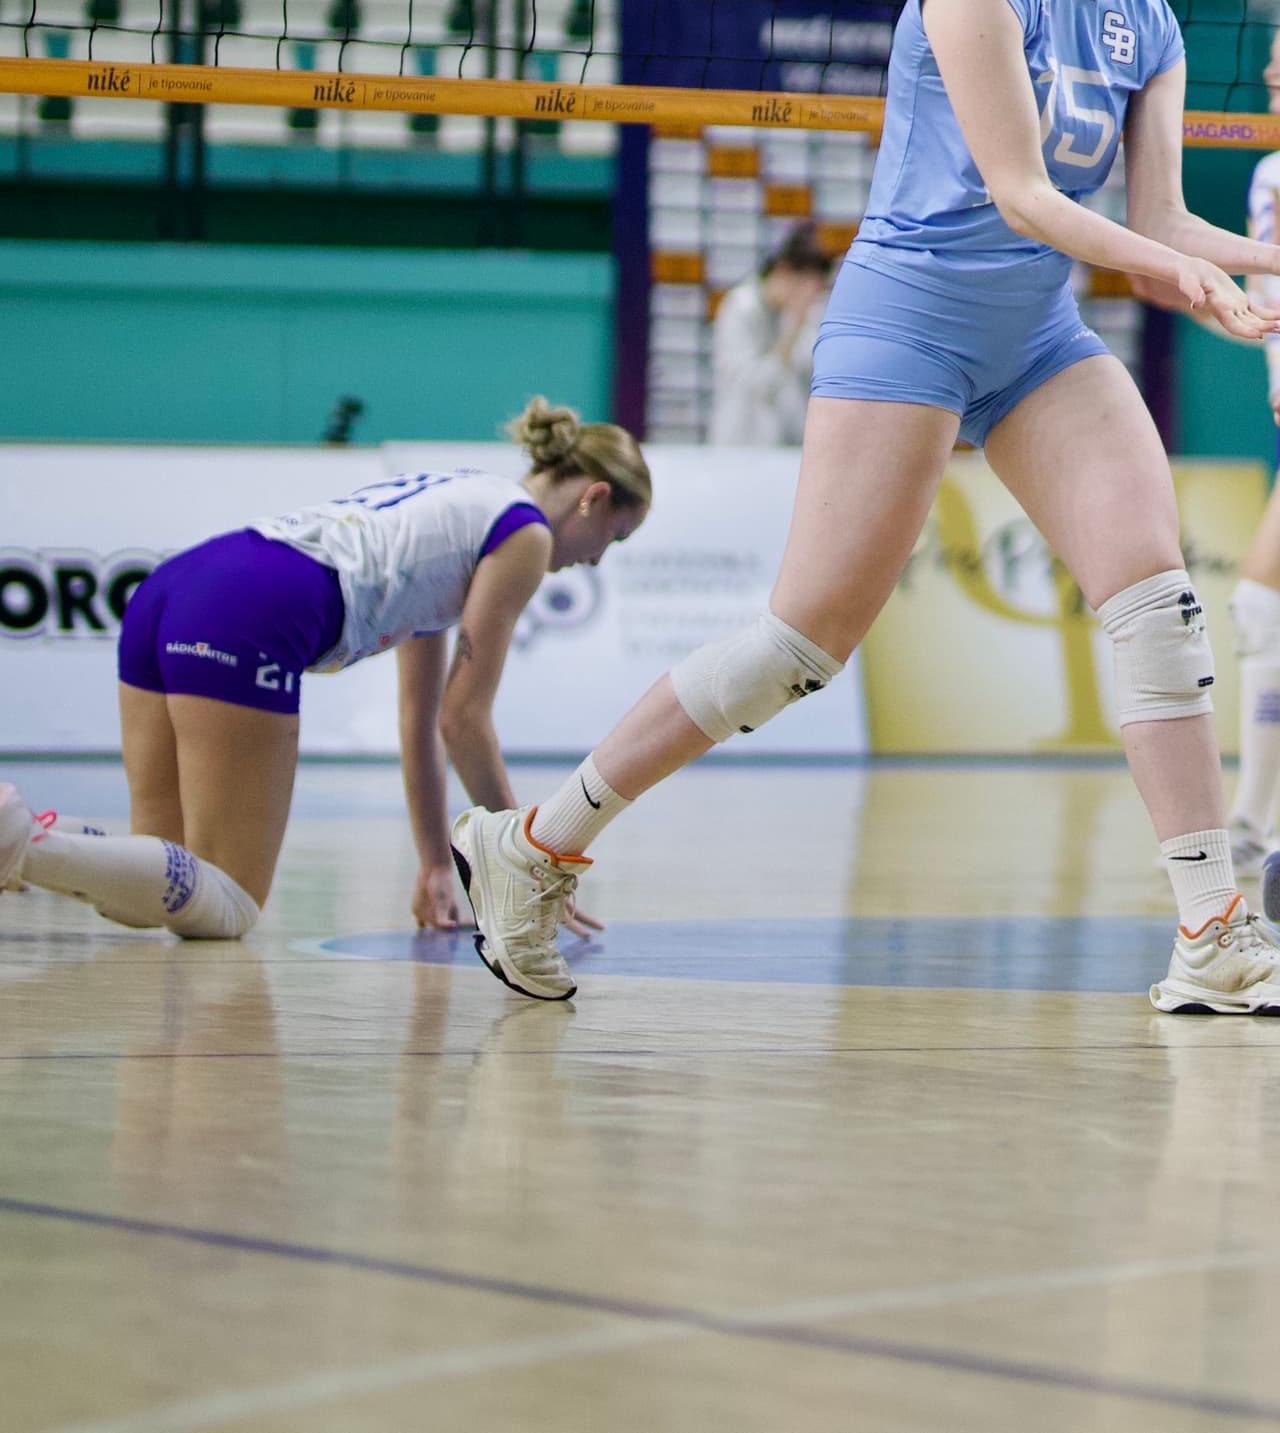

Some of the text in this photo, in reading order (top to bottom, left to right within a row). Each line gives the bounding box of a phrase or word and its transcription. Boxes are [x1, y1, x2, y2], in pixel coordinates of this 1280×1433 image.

[87, 67, 131, 91] niké
[160, 77, 213, 92] tipovanie
[313, 78, 356, 104] niké
[385, 87, 436, 104] tipovanie
[534, 88, 577, 113] niké
[751, 98, 792, 123] niké
